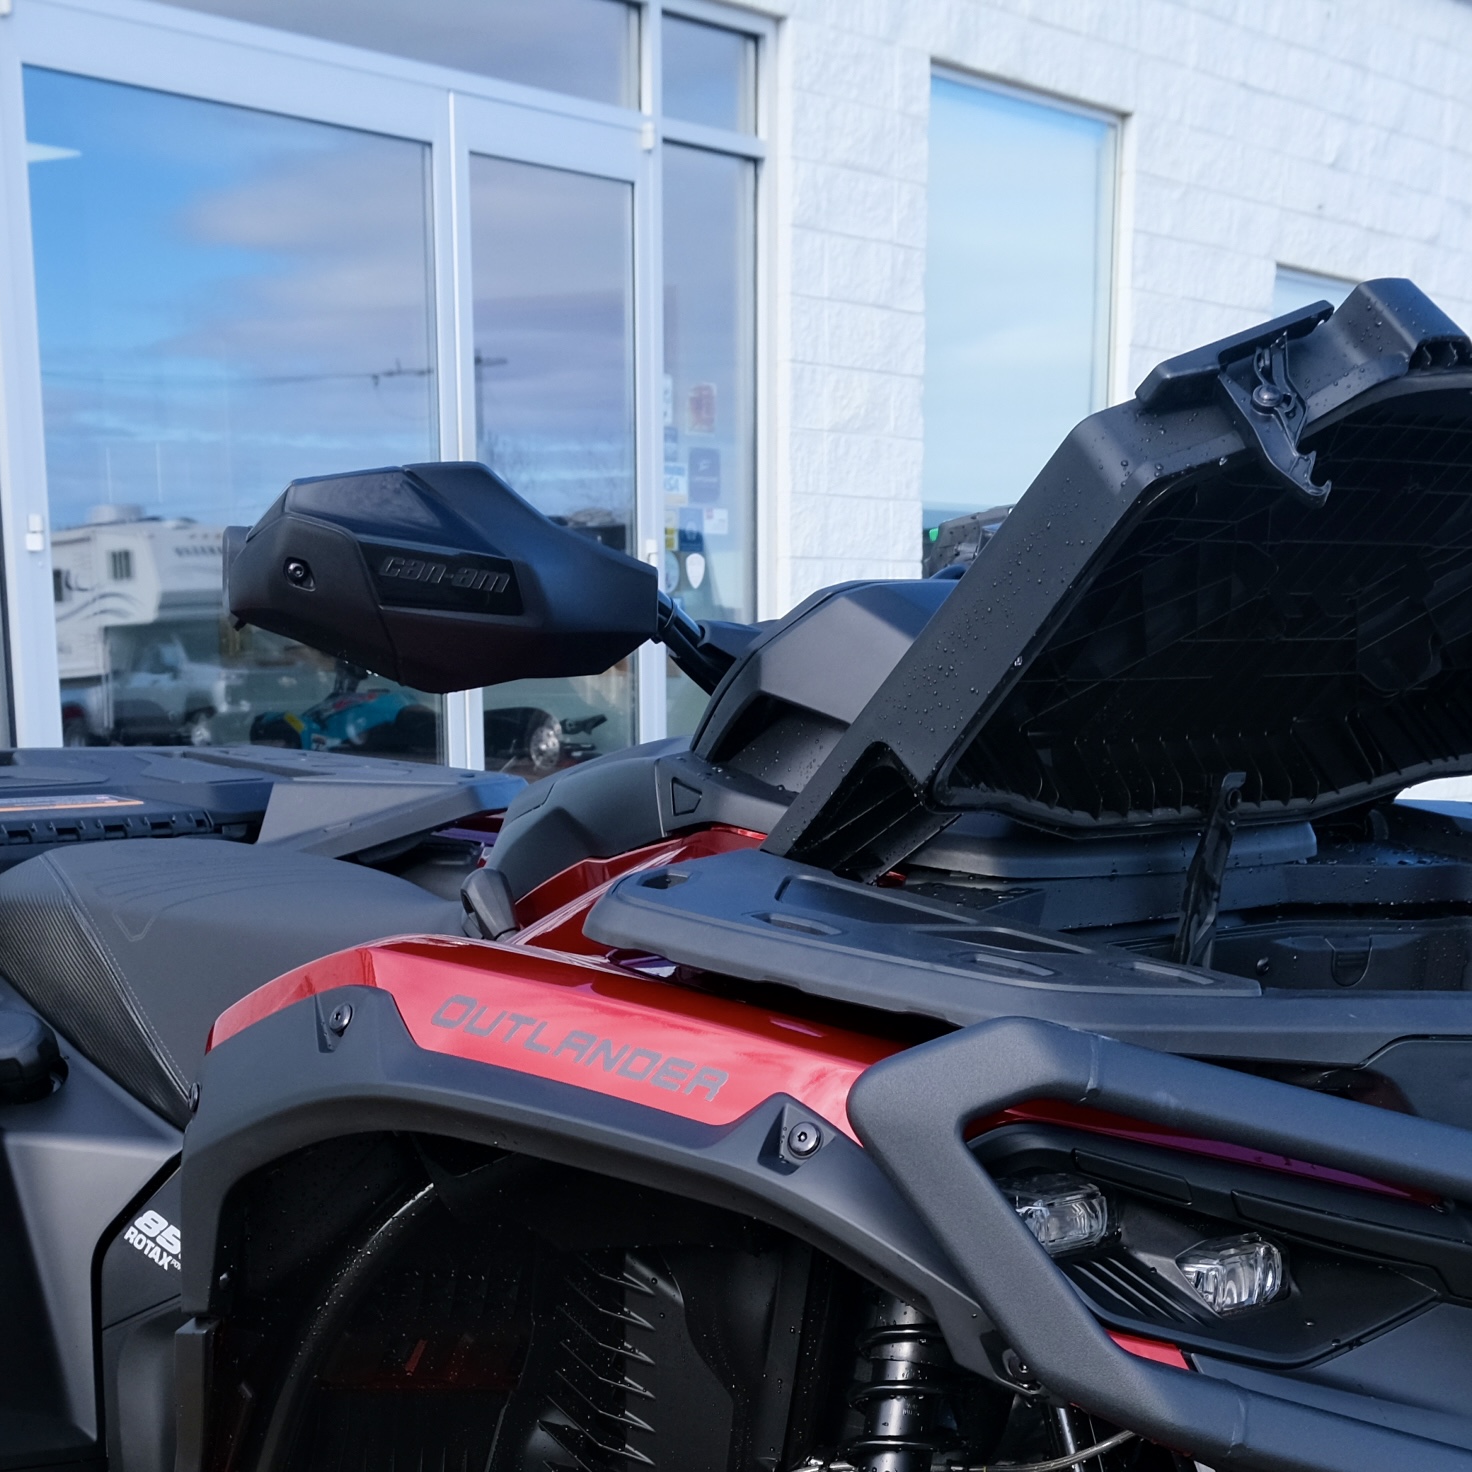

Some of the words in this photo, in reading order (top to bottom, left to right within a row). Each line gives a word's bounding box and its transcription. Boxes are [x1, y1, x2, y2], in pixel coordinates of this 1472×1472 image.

[378, 556, 511, 593] can-am
[430, 994, 729, 1102] OUTLANDER
[123, 1225, 173, 1271] ROTAX
[133, 1209, 181, 1260] 85
